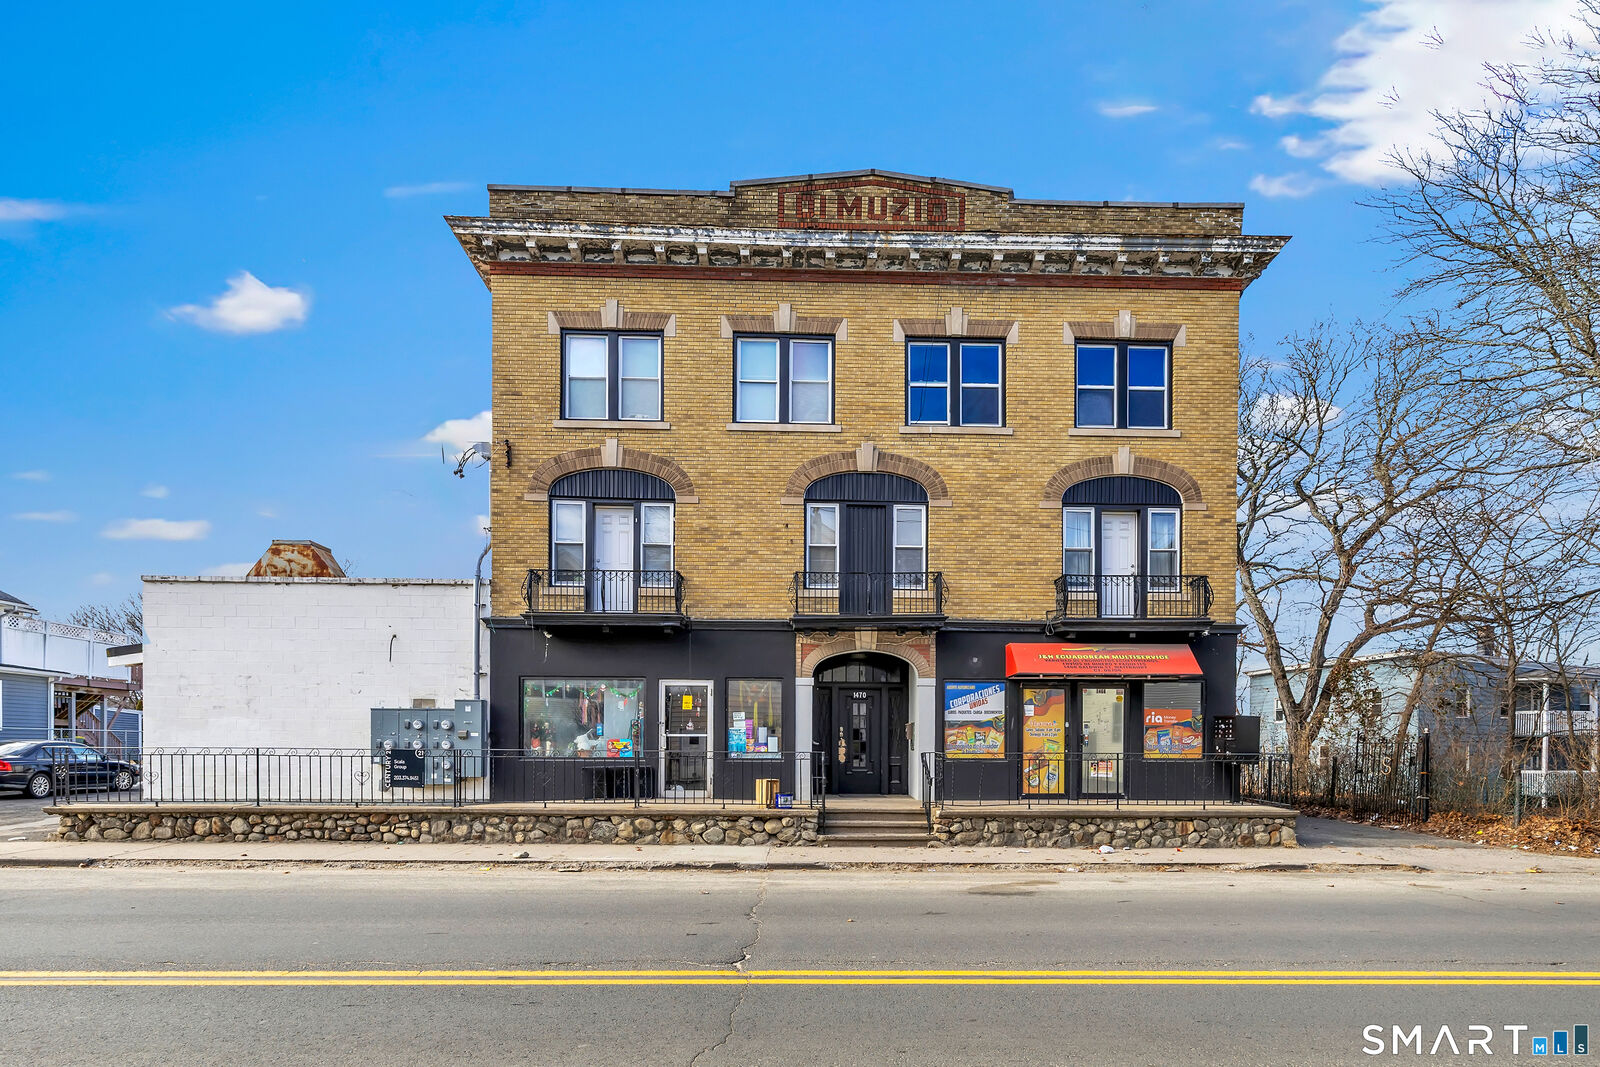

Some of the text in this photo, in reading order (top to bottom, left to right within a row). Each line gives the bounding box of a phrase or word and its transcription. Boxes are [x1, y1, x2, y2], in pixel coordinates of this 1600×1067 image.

[837, 195, 948, 221] MUZIO
[949, 685, 1000, 709] CORPORACIONES
[969, 697, 988, 709] UNIDAS
[1146, 711, 1163, 724] ria
